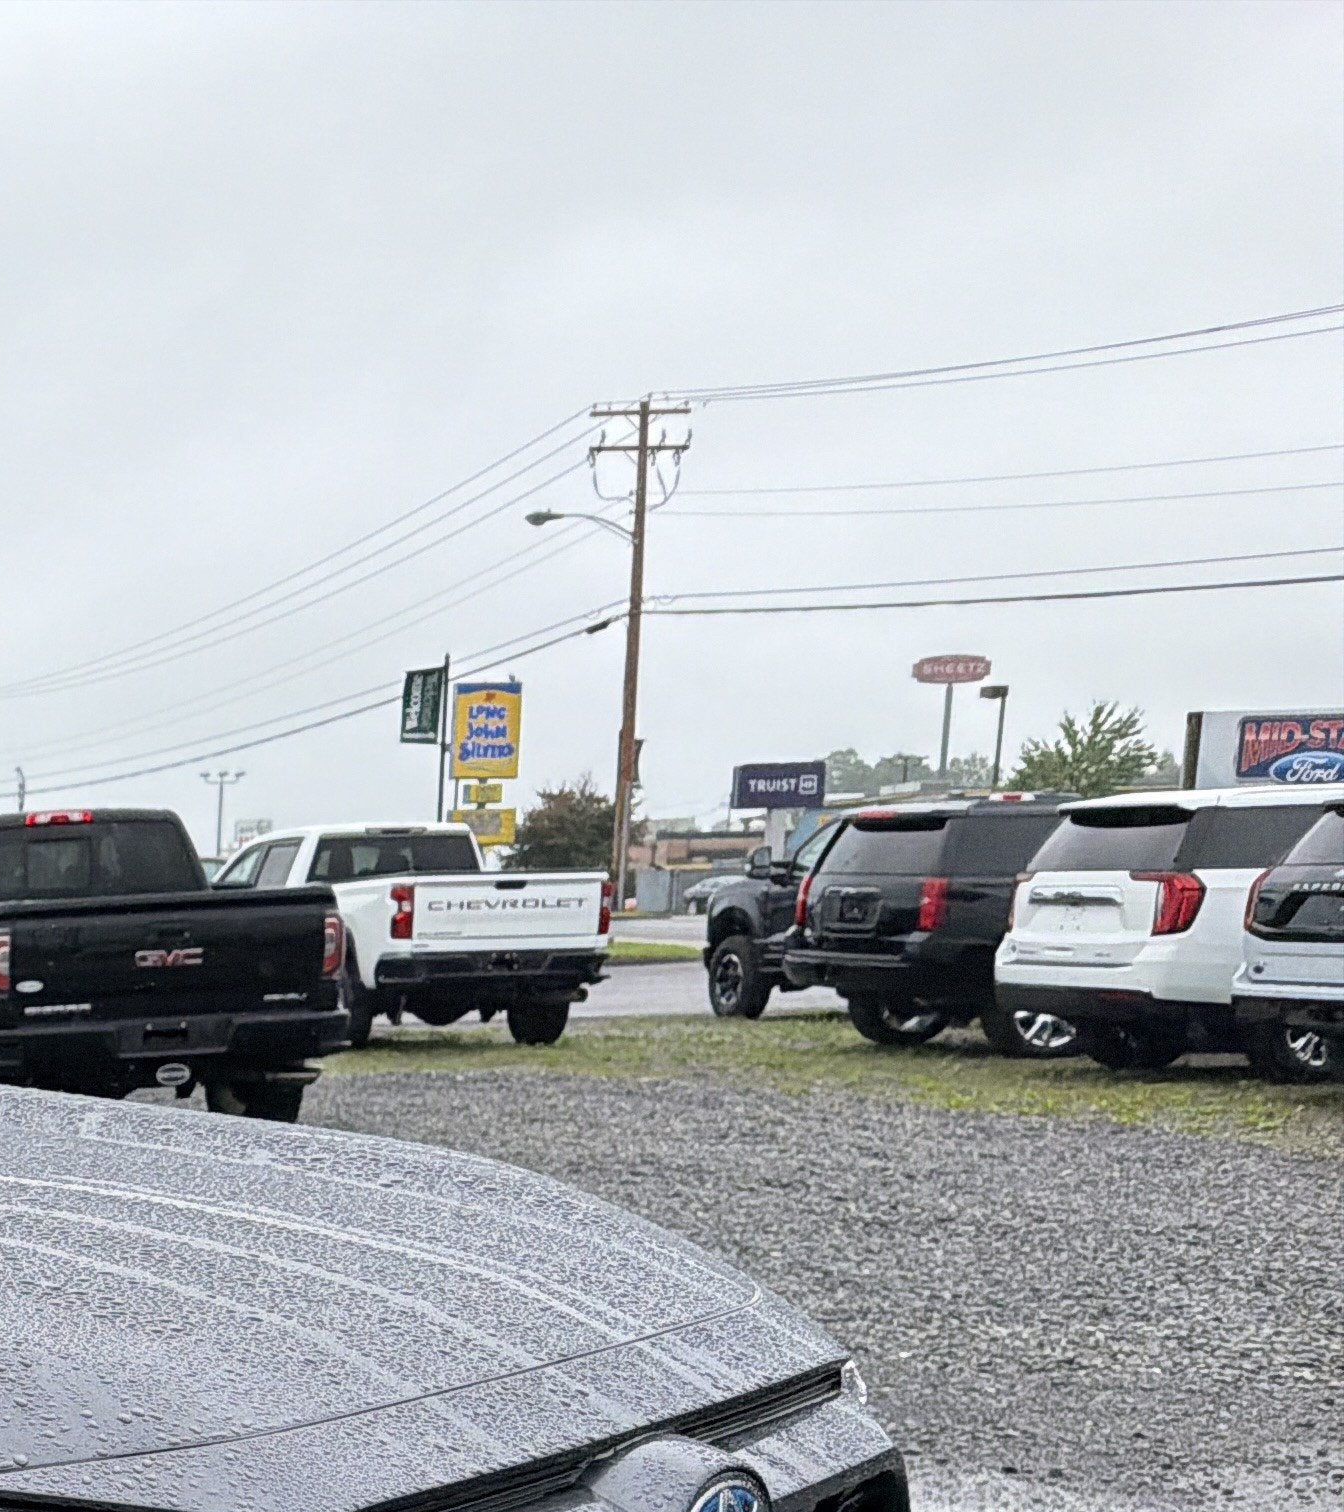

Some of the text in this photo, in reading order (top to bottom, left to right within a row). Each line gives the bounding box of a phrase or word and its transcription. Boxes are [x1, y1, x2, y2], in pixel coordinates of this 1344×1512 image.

[1286, 757, 1342, 782] Ford
[748, 778, 798, 793] TRUIST
[428, 897, 588, 911] CHEVROLET
[134, 947, 204, 967] GMC
